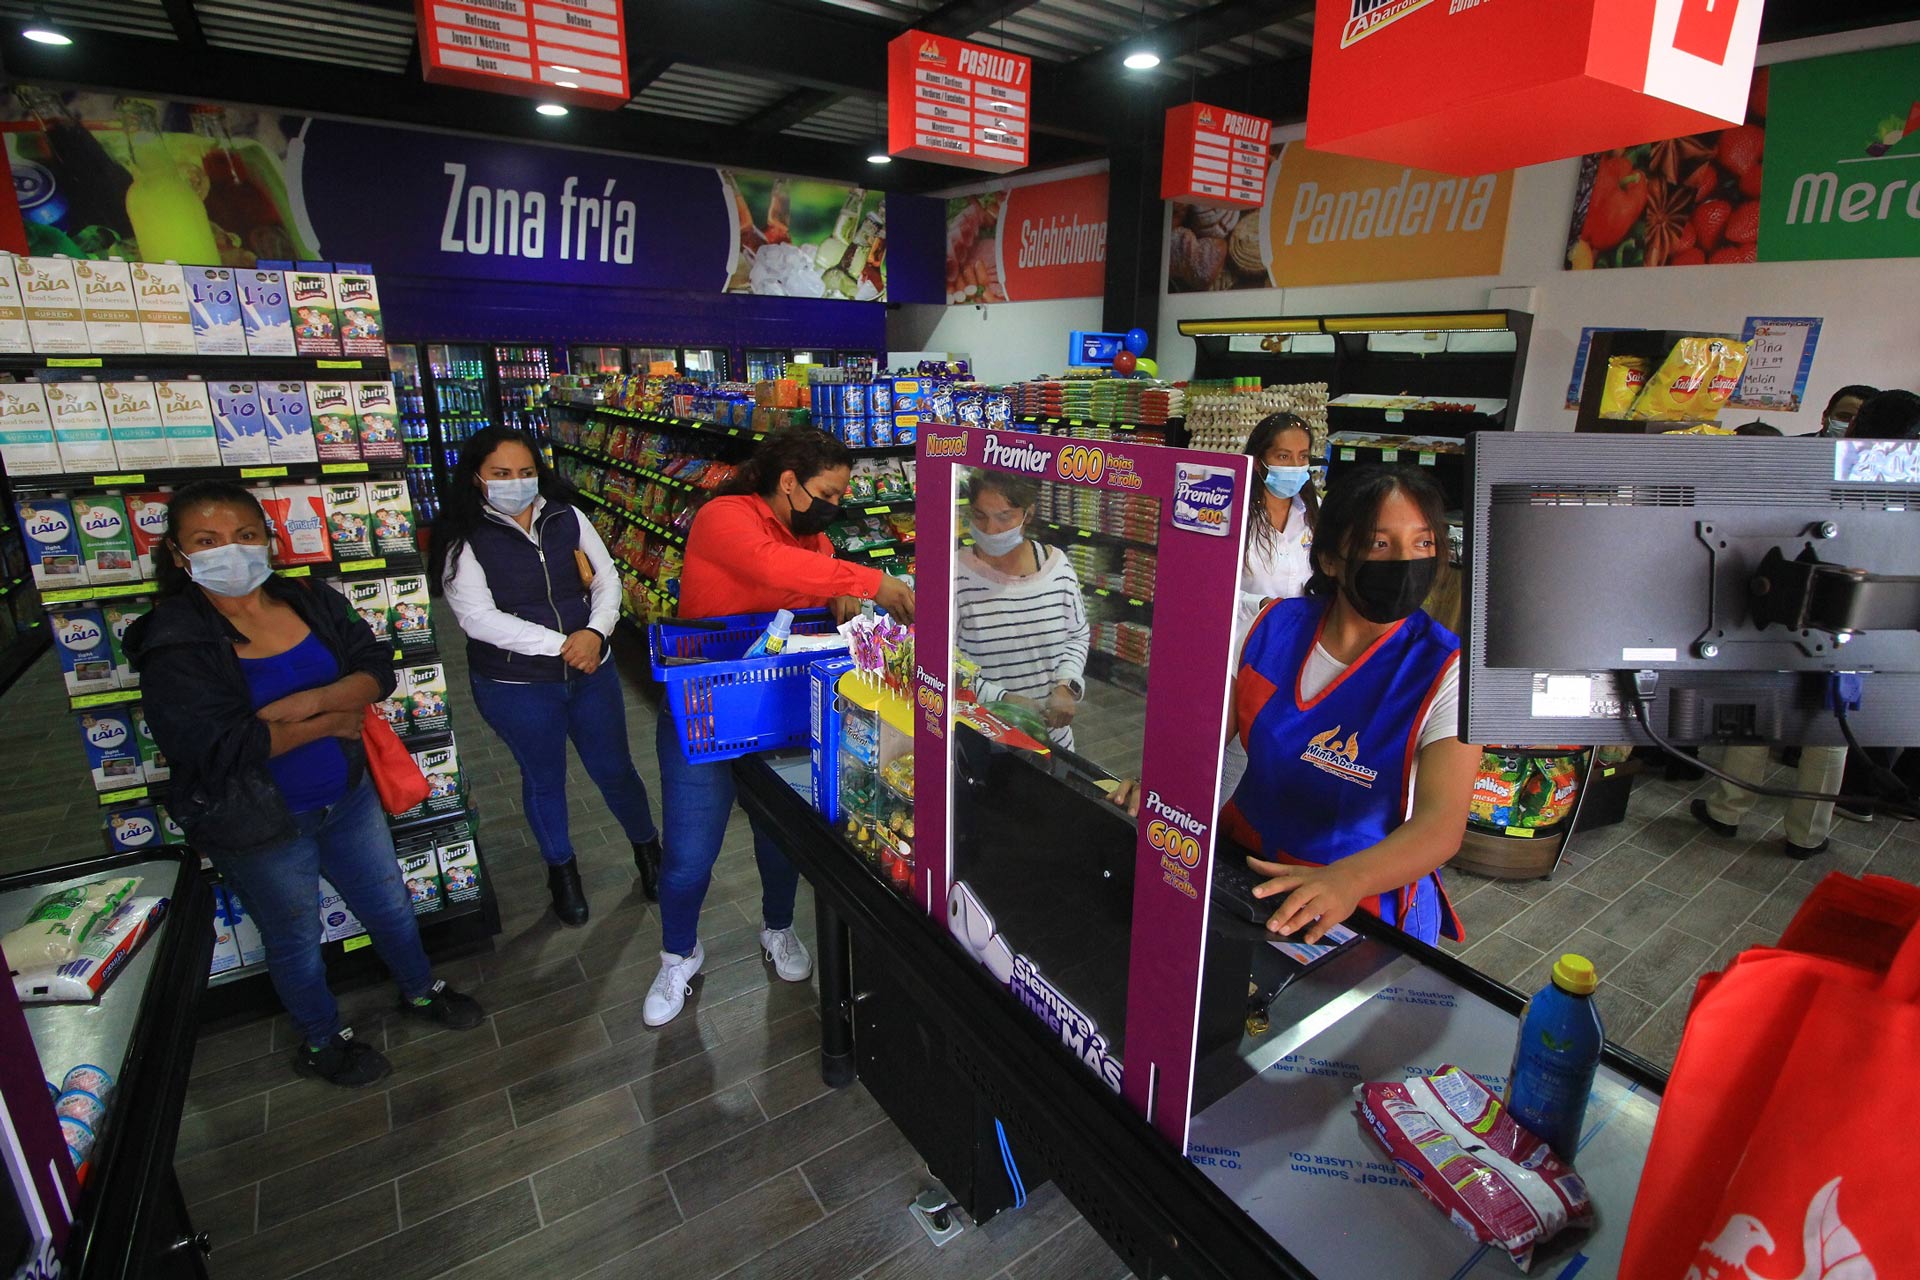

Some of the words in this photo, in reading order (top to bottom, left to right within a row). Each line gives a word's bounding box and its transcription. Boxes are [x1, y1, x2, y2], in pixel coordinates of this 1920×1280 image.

[464, 12, 500, 31] Refrescos
[566, 12, 592, 29] Botanas
[452, 31, 472, 46] Jugos
[476, 56, 498, 70] Aguas
[958, 48, 1015, 83] PASILLO
[1015, 62, 1026, 85] 7
[1222, 113, 1260, 139] PASILLO
[1260, 122, 1269, 141] 8
[440, 162, 546, 259] Zona
[559, 176, 636, 265] fría
[293, 278, 325, 292] Nutri
[340, 280, 370, 294] Nutri
[314, 386, 345, 400] Nutri
[359, 385, 388, 400] Nutri
[926, 431, 968, 457] Nuevo!
[982, 434, 1051, 473] Premier
[1057, 444, 1105, 483] 600
[1106, 453, 1134, 472] hojas
[1118, 473, 1142, 489] rollo
[327, 487, 360, 503] Nutri
[371, 485, 404, 501] Nutri
[1177, 482, 1229, 506] Premier
[86, 517, 120, 530] LALA
[1198, 507, 1223, 525] 600
[31, 521, 67, 535] LALA
[349, 583, 381, 600] Nutri
[391, 578, 422, 595] Nutri
[65, 628, 99, 643] LALA
[409, 667, 439, 684] Nutri
[916, 664, 946, 692] Premier
[917, 685, 944, 717] 600
[92, 727, 126, 742] LALA
[847, 726, 869, 748] Trident
[422, 750, 451, 767] Nutri
[1146, 791, 1207, 836] Premier
[120, 825, 153, 840] LALA
[1147, 819, 1201, 868] 600
[443, 844, 470, 862] Nutri
[402, 854, 430, 872] Nutri
[1161, 855, 1190, 880] hojas
[1012, 955, 1091, 1038] Siempre
[1377, 993, 1395, 1002] iber
[1407, 988, 1455, 1001] Solution
[1010, 975, 1061, 1034] rinde
[1061, 1020, 1122, 1095] MÁS
[1309, 1057, 1360, 1071] Solution
[1273, 1063, 1295, 1073] iber
[1304, 1066, 1338, 1077] LASER
[1187, 1154, 1216, 1167] ASER
[1315, 1155, 1354, 1169] LASER
[1291, 1164, 1349, 1181] Solution
